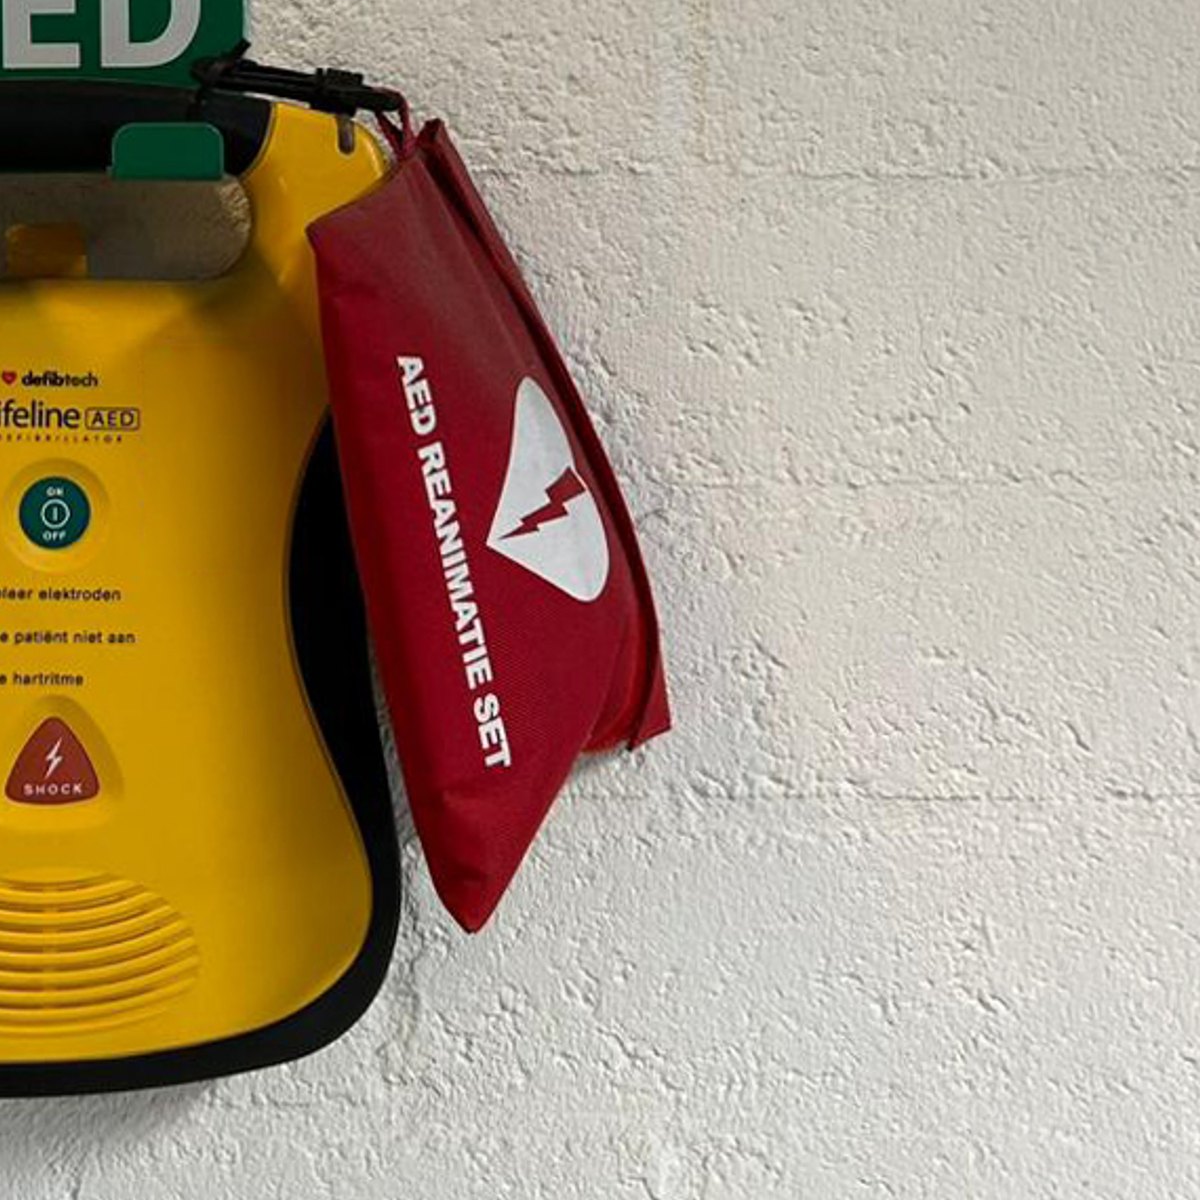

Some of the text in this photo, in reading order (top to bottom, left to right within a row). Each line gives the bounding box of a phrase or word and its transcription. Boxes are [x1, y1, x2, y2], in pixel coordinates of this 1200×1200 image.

[22, 371, 99, 387] defibtech
[91, 411, 135, 427] AED
[46, 487, 64, 497] ON
[42, 530, 67, 542] OFF
[396, 356, 512, 767] AED REANIMATIE SET
[38, 587, 121, 601] elektroden
[73, 630, 103, 644] niet
[107, 633, 136, 644] aan
[13, 672, 84, 685] hartritme
[23, 783, 83, 795] SHOCK
